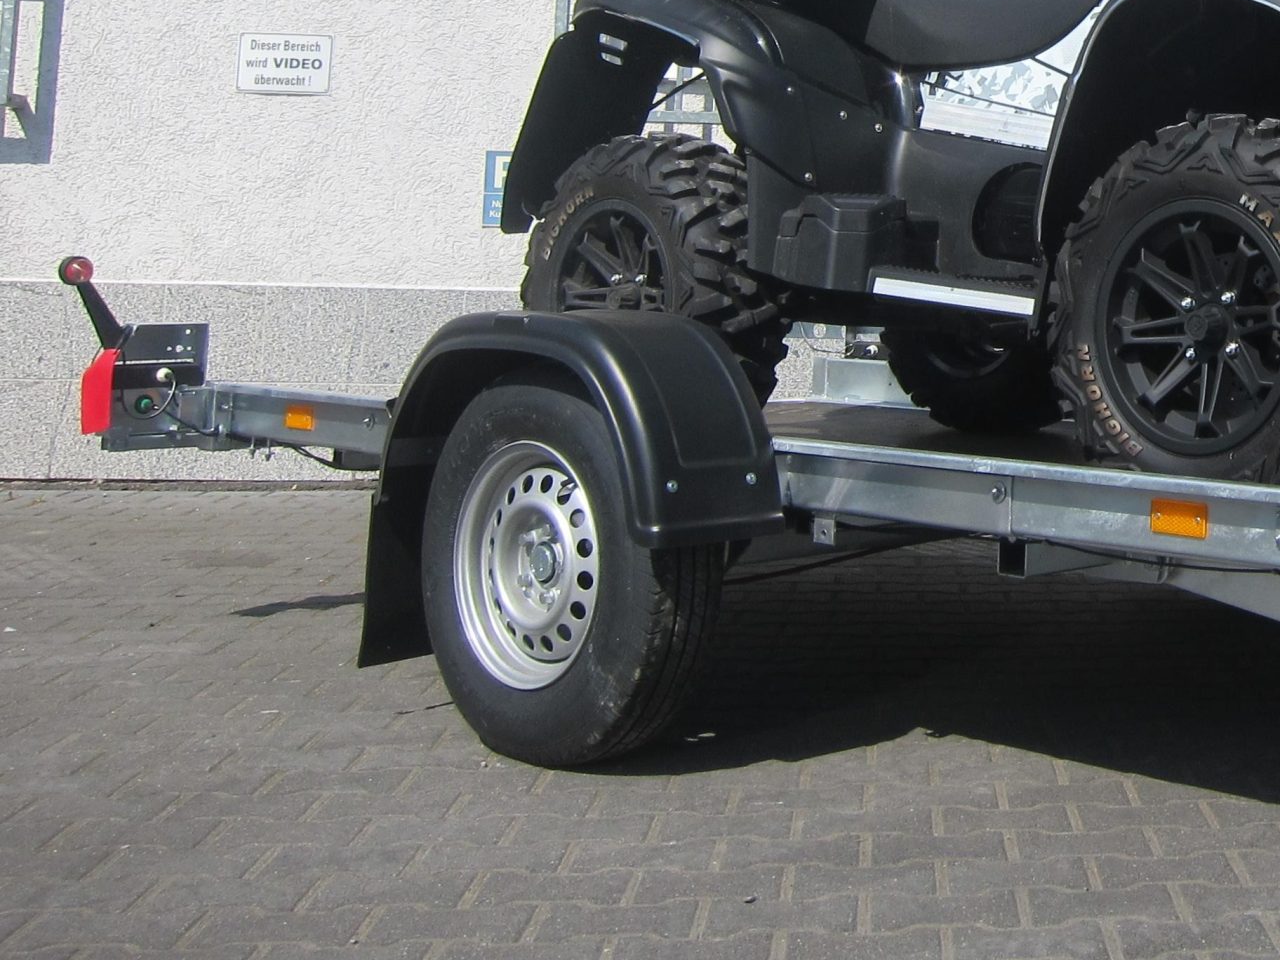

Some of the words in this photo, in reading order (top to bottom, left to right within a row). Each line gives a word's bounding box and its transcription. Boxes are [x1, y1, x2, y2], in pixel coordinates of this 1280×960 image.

[250, 39, 281, 51] Dieser
[283, 40, 321, 52] Bereich
[246, 57, 268, 68] wird
[273, 57, 323, 70] VIDEO
[1077, 344, 1144, 457] BIGHORN
